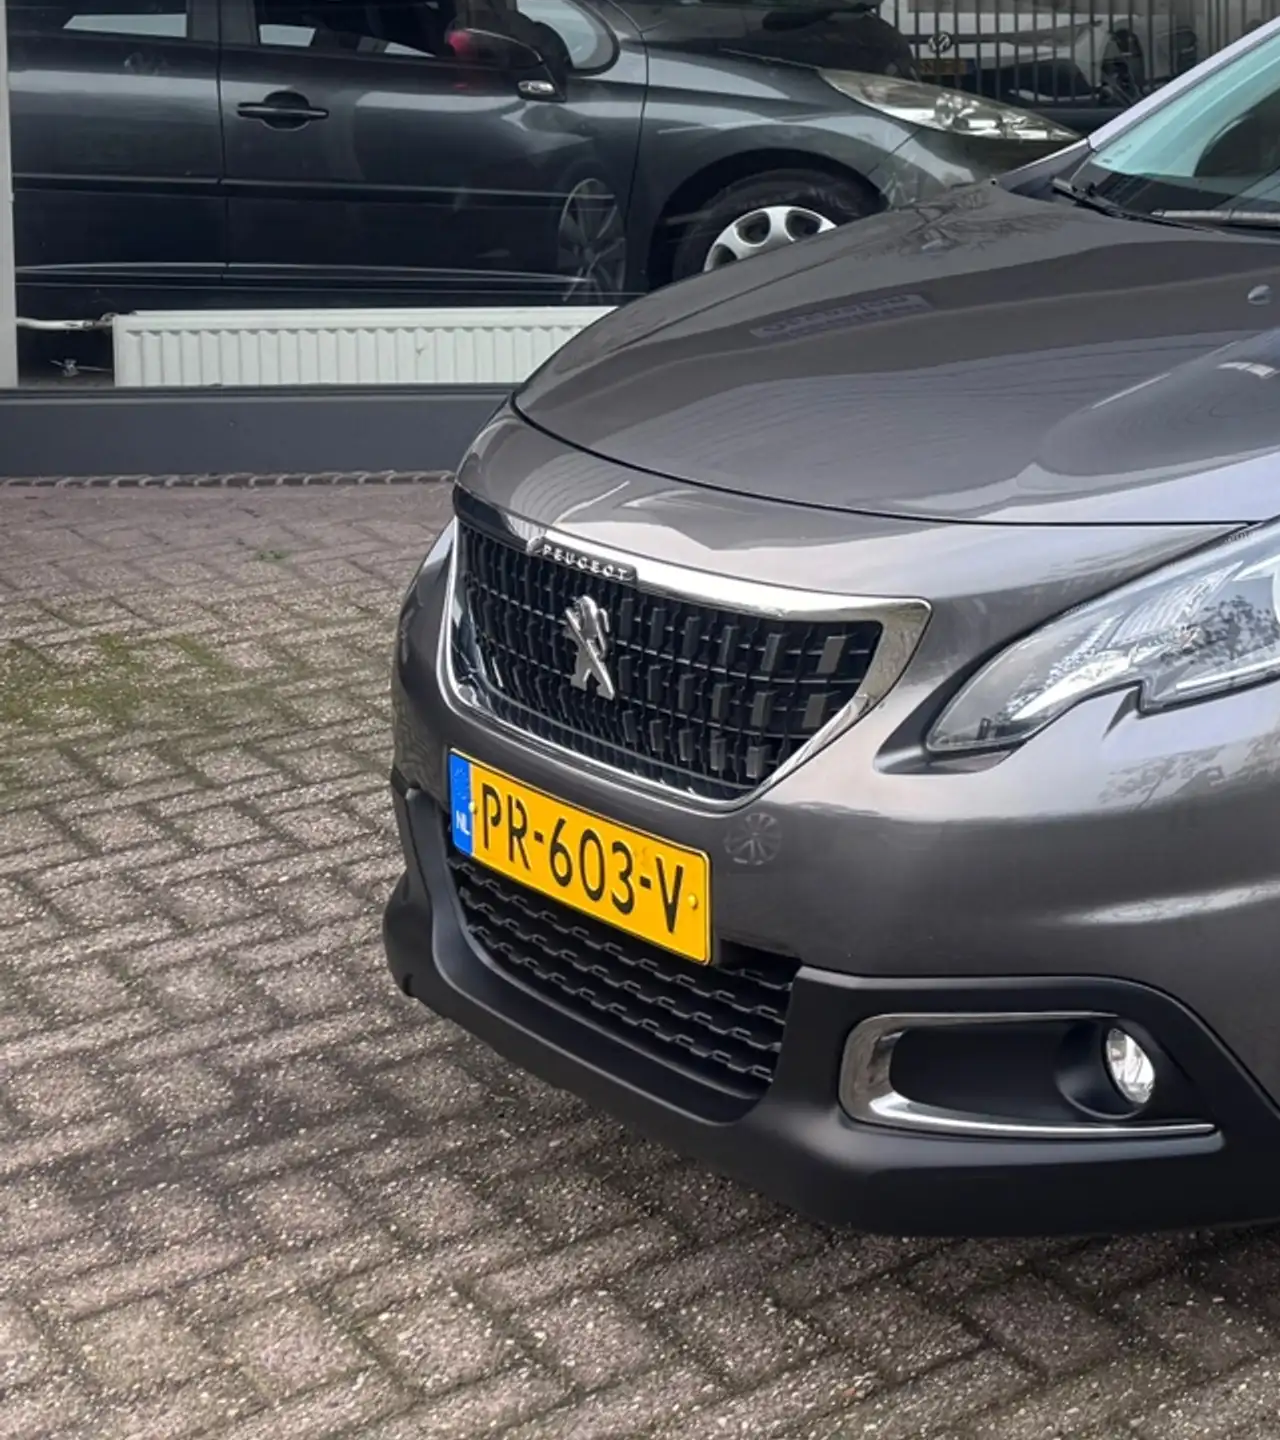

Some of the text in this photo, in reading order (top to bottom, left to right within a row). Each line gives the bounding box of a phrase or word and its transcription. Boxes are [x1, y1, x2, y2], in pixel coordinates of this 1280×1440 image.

[542, 544, 628, 581] PEUGEOT
[455, 782, 684, 935] NL PR-603-V
